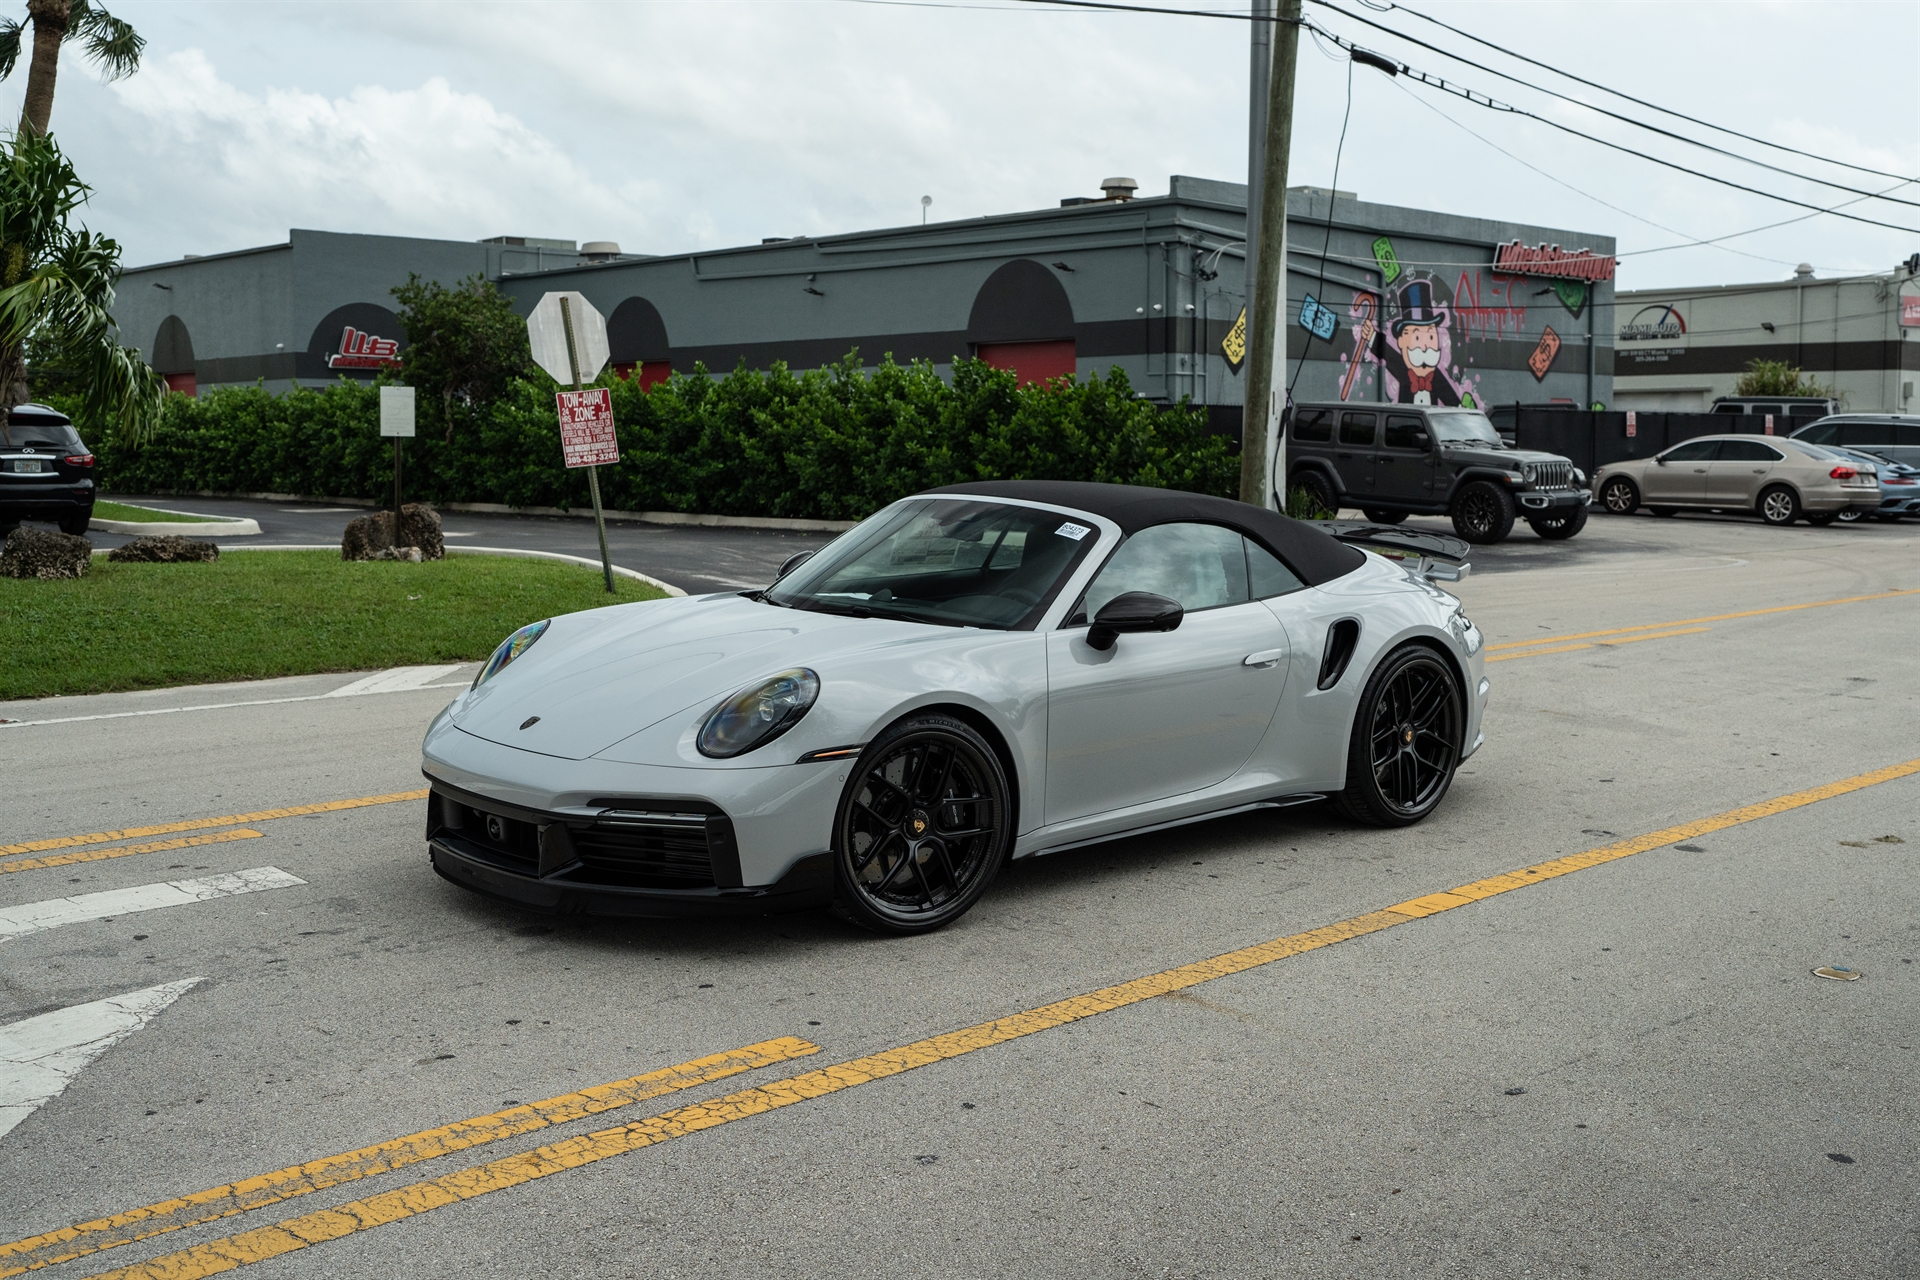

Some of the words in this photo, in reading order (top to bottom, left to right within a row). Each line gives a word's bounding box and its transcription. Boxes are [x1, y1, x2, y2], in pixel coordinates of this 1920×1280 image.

[1620, 325, 1652, 334] MIAMI
[1652, 323, 1682, 333] AUTO
[562, 391, 603, 408] TOW-AWAY
[574, 407, 596, 421] ZONE
[598, 411, 610, 419] DAYS
[928, 720, 964, 730] MICHELIN
